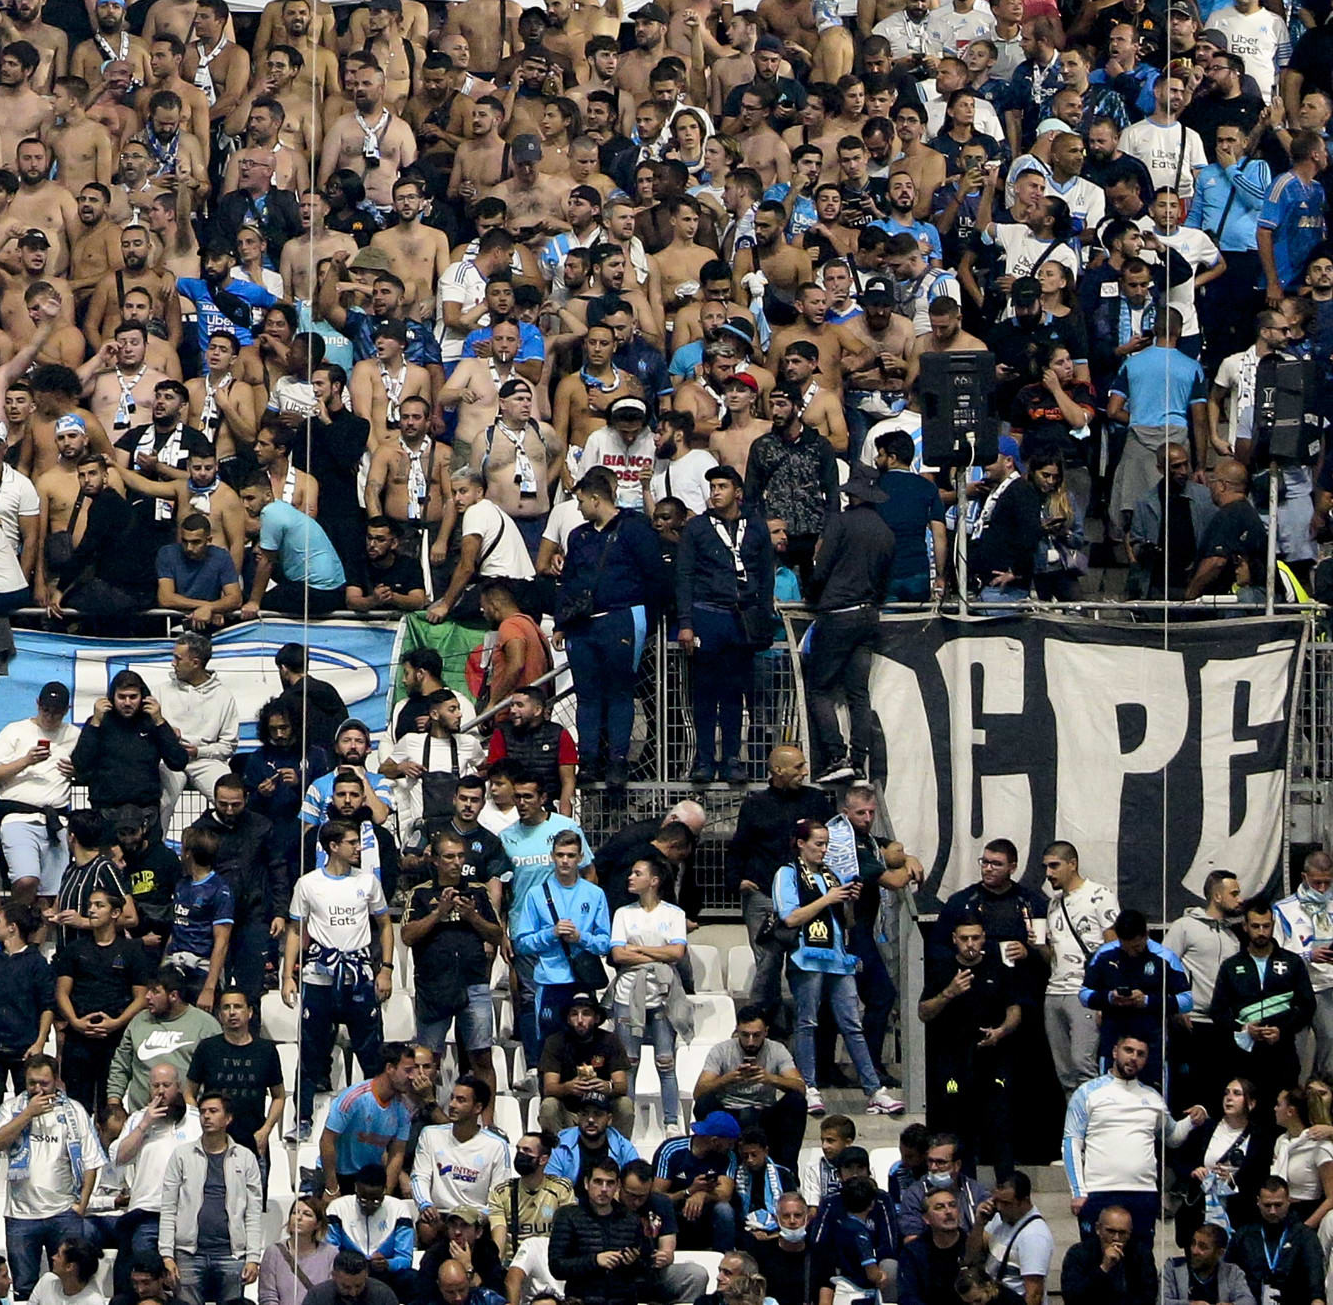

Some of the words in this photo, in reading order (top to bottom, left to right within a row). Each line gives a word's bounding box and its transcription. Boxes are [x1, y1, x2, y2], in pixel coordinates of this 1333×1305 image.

[1230, 34, 1259, 45] Uber
[1231, 44, 1258, 55] Eats
[1152, 149, 1176, 160] Uber
[1151, 158, 1176, 170] Eats
[325, 334, 350, 348] ange
[328, 905, 356, 916] Uber
[329, 915, 357, 927] Eats
[146, 1030, 183, 1048] NIKE
[452, 1165, 479, 1175] INTER
[452, 1172, 477, 1183] SPORT
